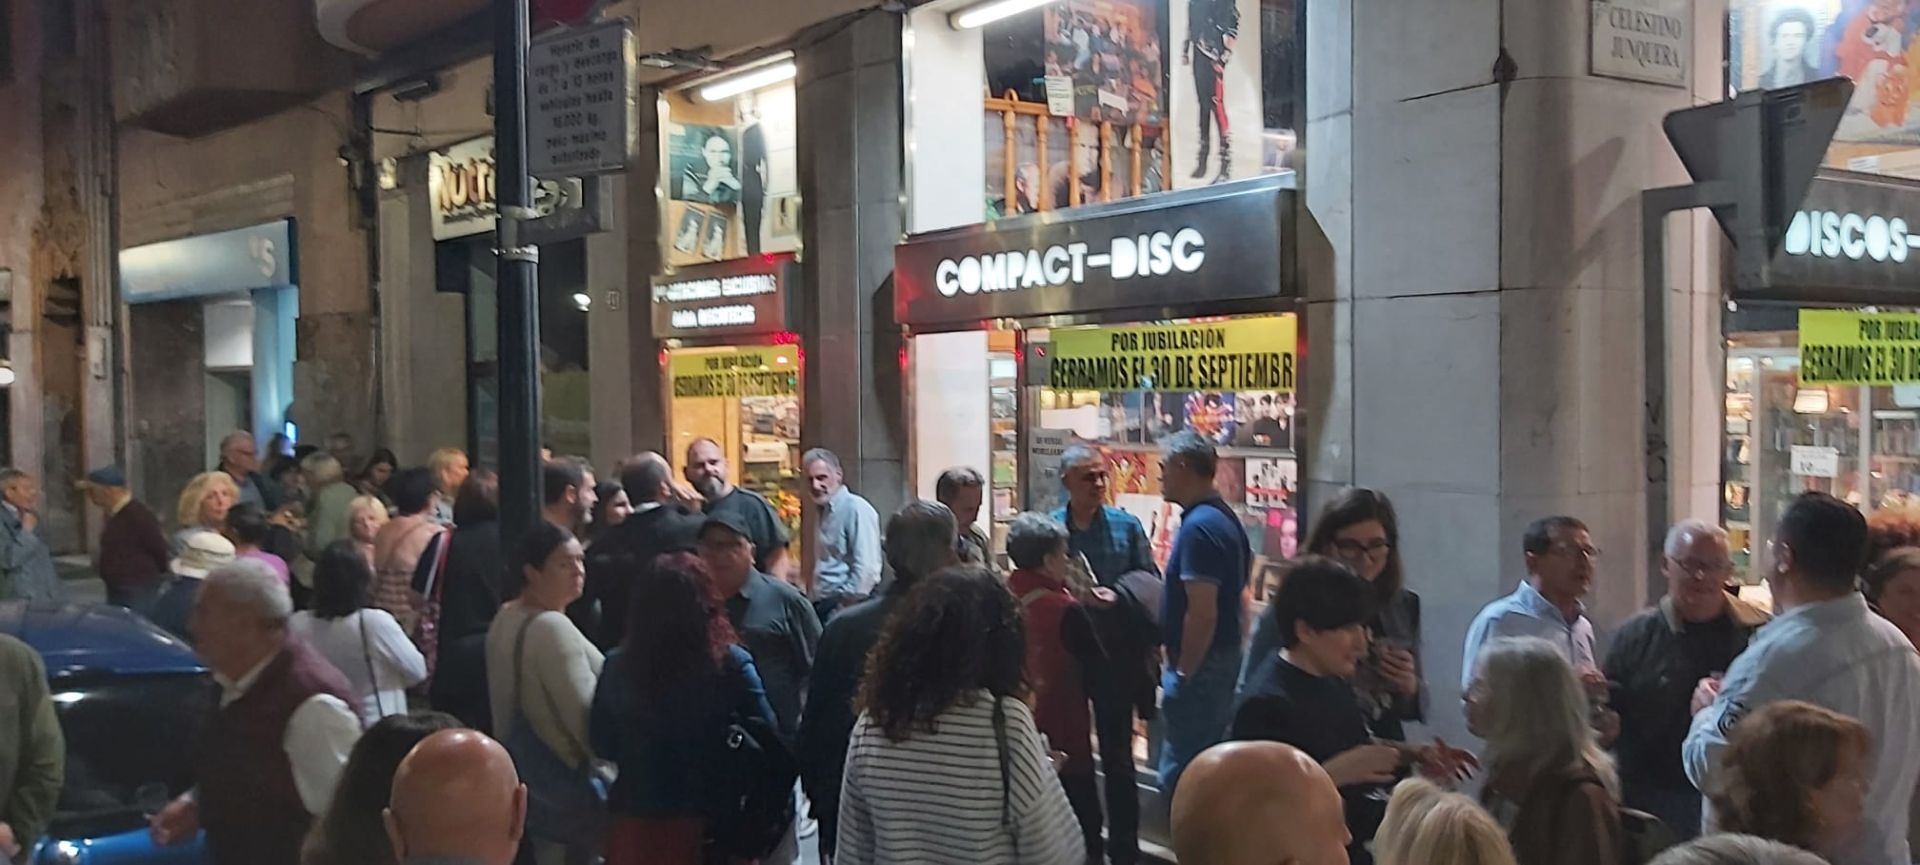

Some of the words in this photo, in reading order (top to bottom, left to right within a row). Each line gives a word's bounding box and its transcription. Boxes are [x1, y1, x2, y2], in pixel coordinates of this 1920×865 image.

[1609, 6, 1682, 40] CELESTINO
[1611, 36, 1680, 68] JUNQUERA
[935, 227, 1205, 297] COMPACT-DISC
[1111, 332, 1139, 352] POR
[1859, 319, 1882, 341] POR
[1051, 356, 1128, 390] CERRAMOS
[1131, 357, 1147, 389] EL
[1151, 356, 1170, 389] 30
[1175, 355, 1197, 388] DE
[1802, 345, 1872, 382] CERRAMOS
